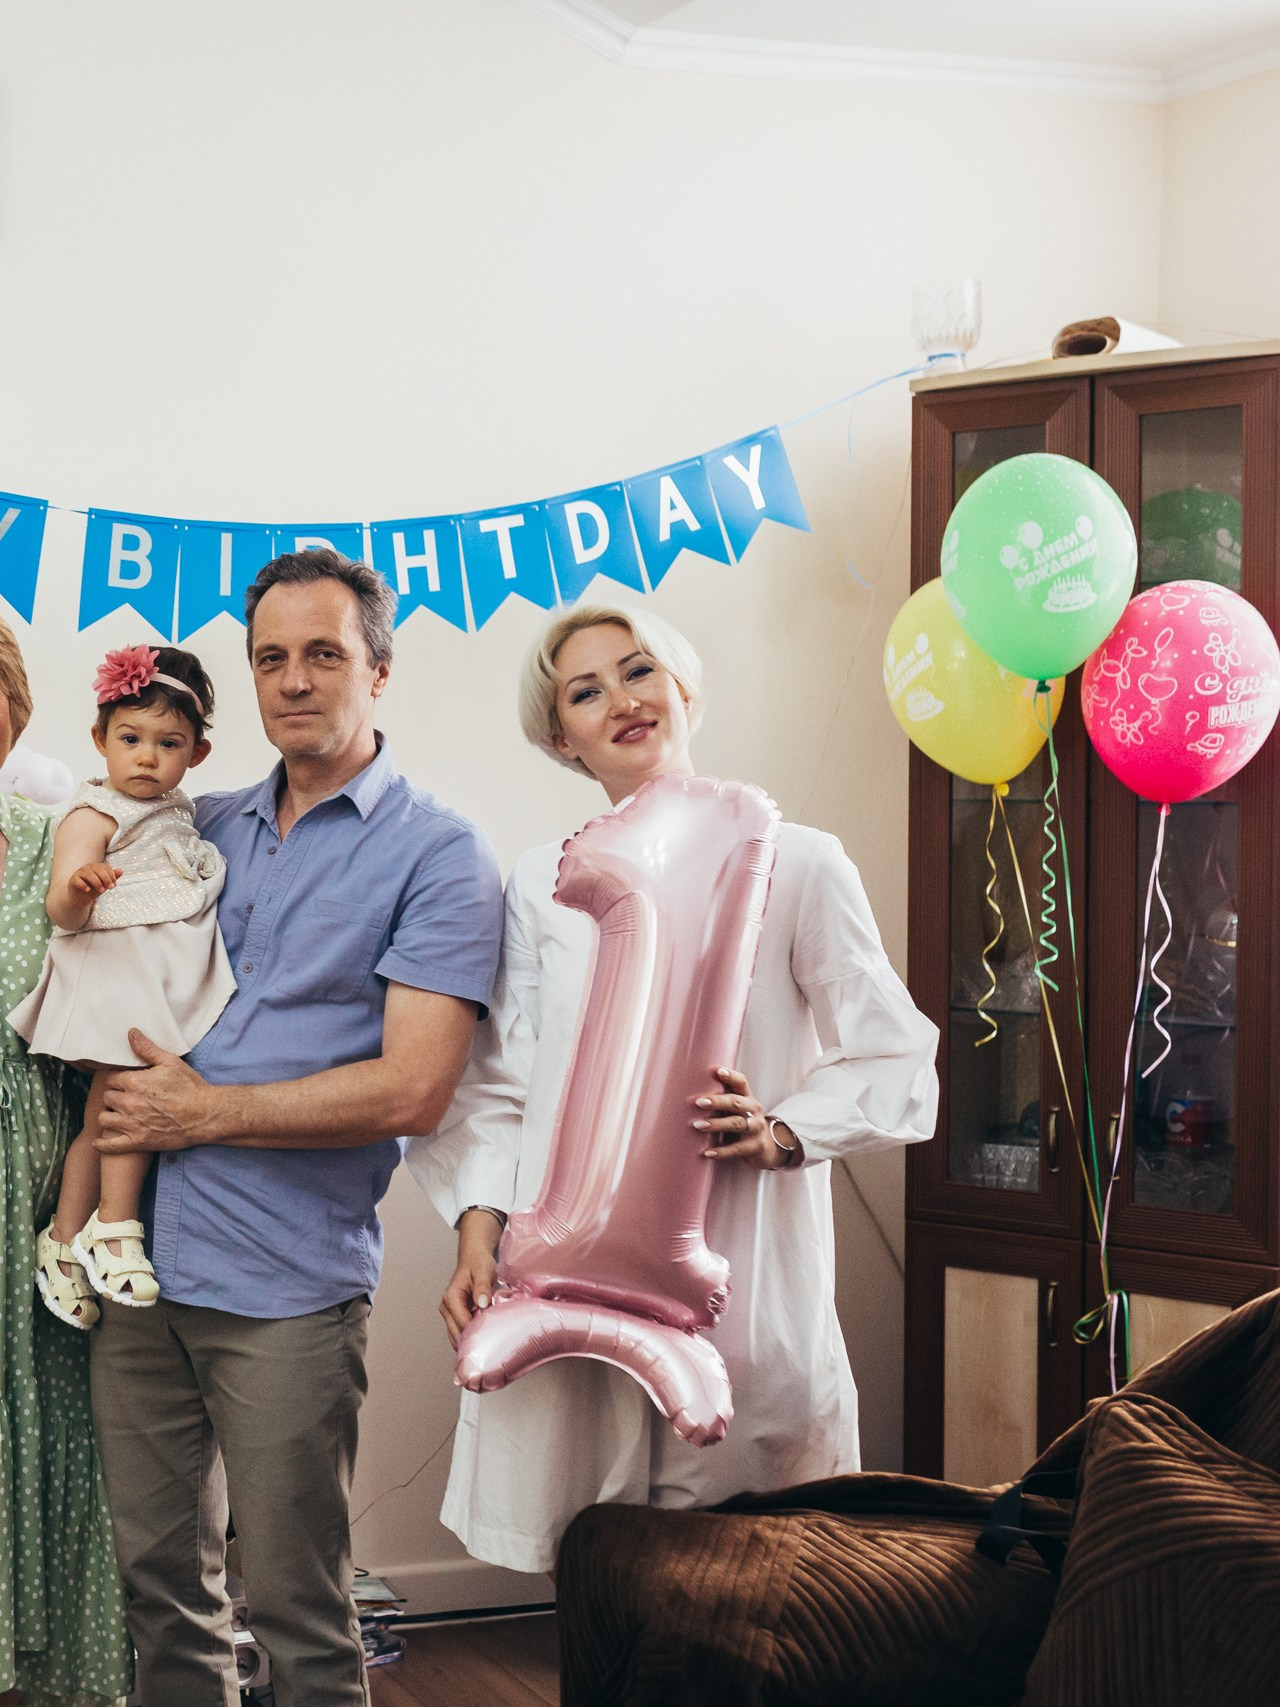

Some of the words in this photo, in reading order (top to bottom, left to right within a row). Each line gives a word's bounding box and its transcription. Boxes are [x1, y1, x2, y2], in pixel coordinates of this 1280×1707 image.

[106, 444, 767, 597] BIHTDAY
[1013, 537, 1099, 592] РОЖДЕНИЯ
[1033, 530, 1080, 567] ДНЕМ
